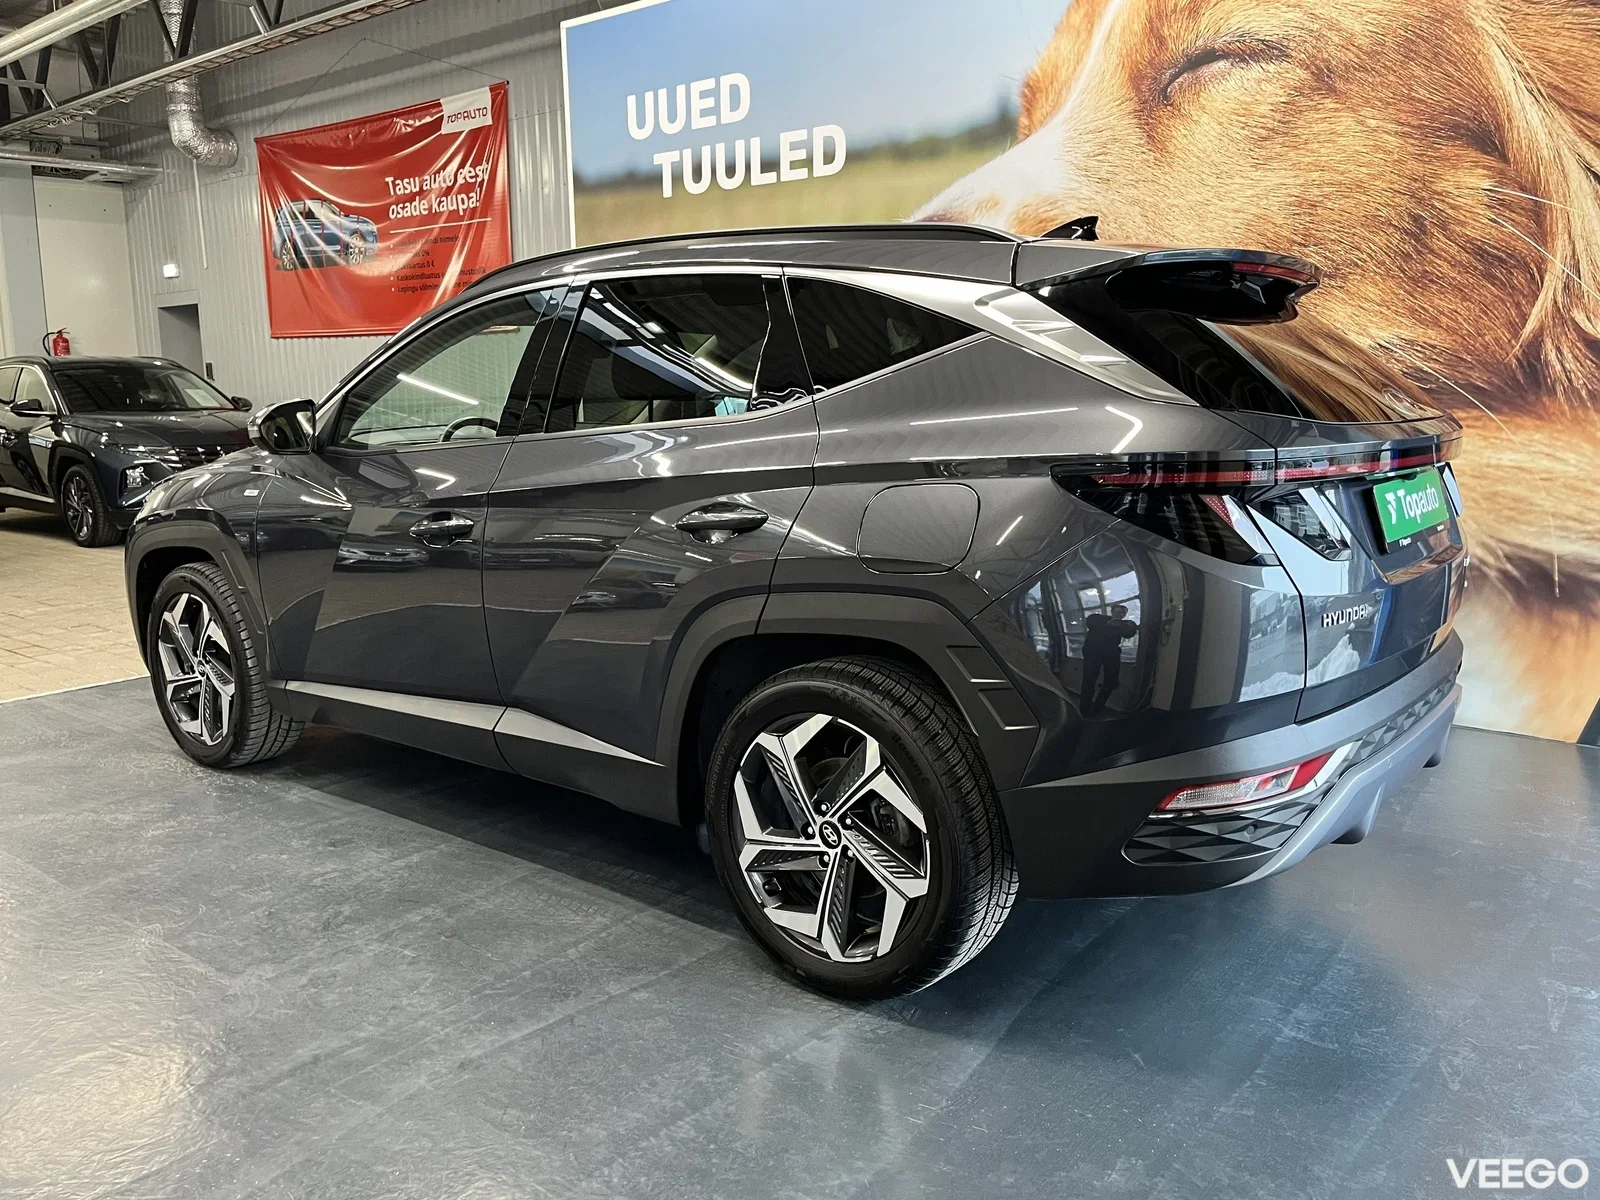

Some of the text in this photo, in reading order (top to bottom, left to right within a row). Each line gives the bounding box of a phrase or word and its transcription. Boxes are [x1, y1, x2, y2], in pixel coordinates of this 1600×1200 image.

[446, 106, 488, 124] TOPAUTO
[627, 72, 751, 140] UUED
[653, 124, 847, 198] TUULED
[385, 163, 489, 196] Tasu auto eest
[389, 187, 480, 220] osade kaupa!
[1396, 483, 1439, 524] Topauto
[1322, 603, 1369, 628] HYUNDAI
